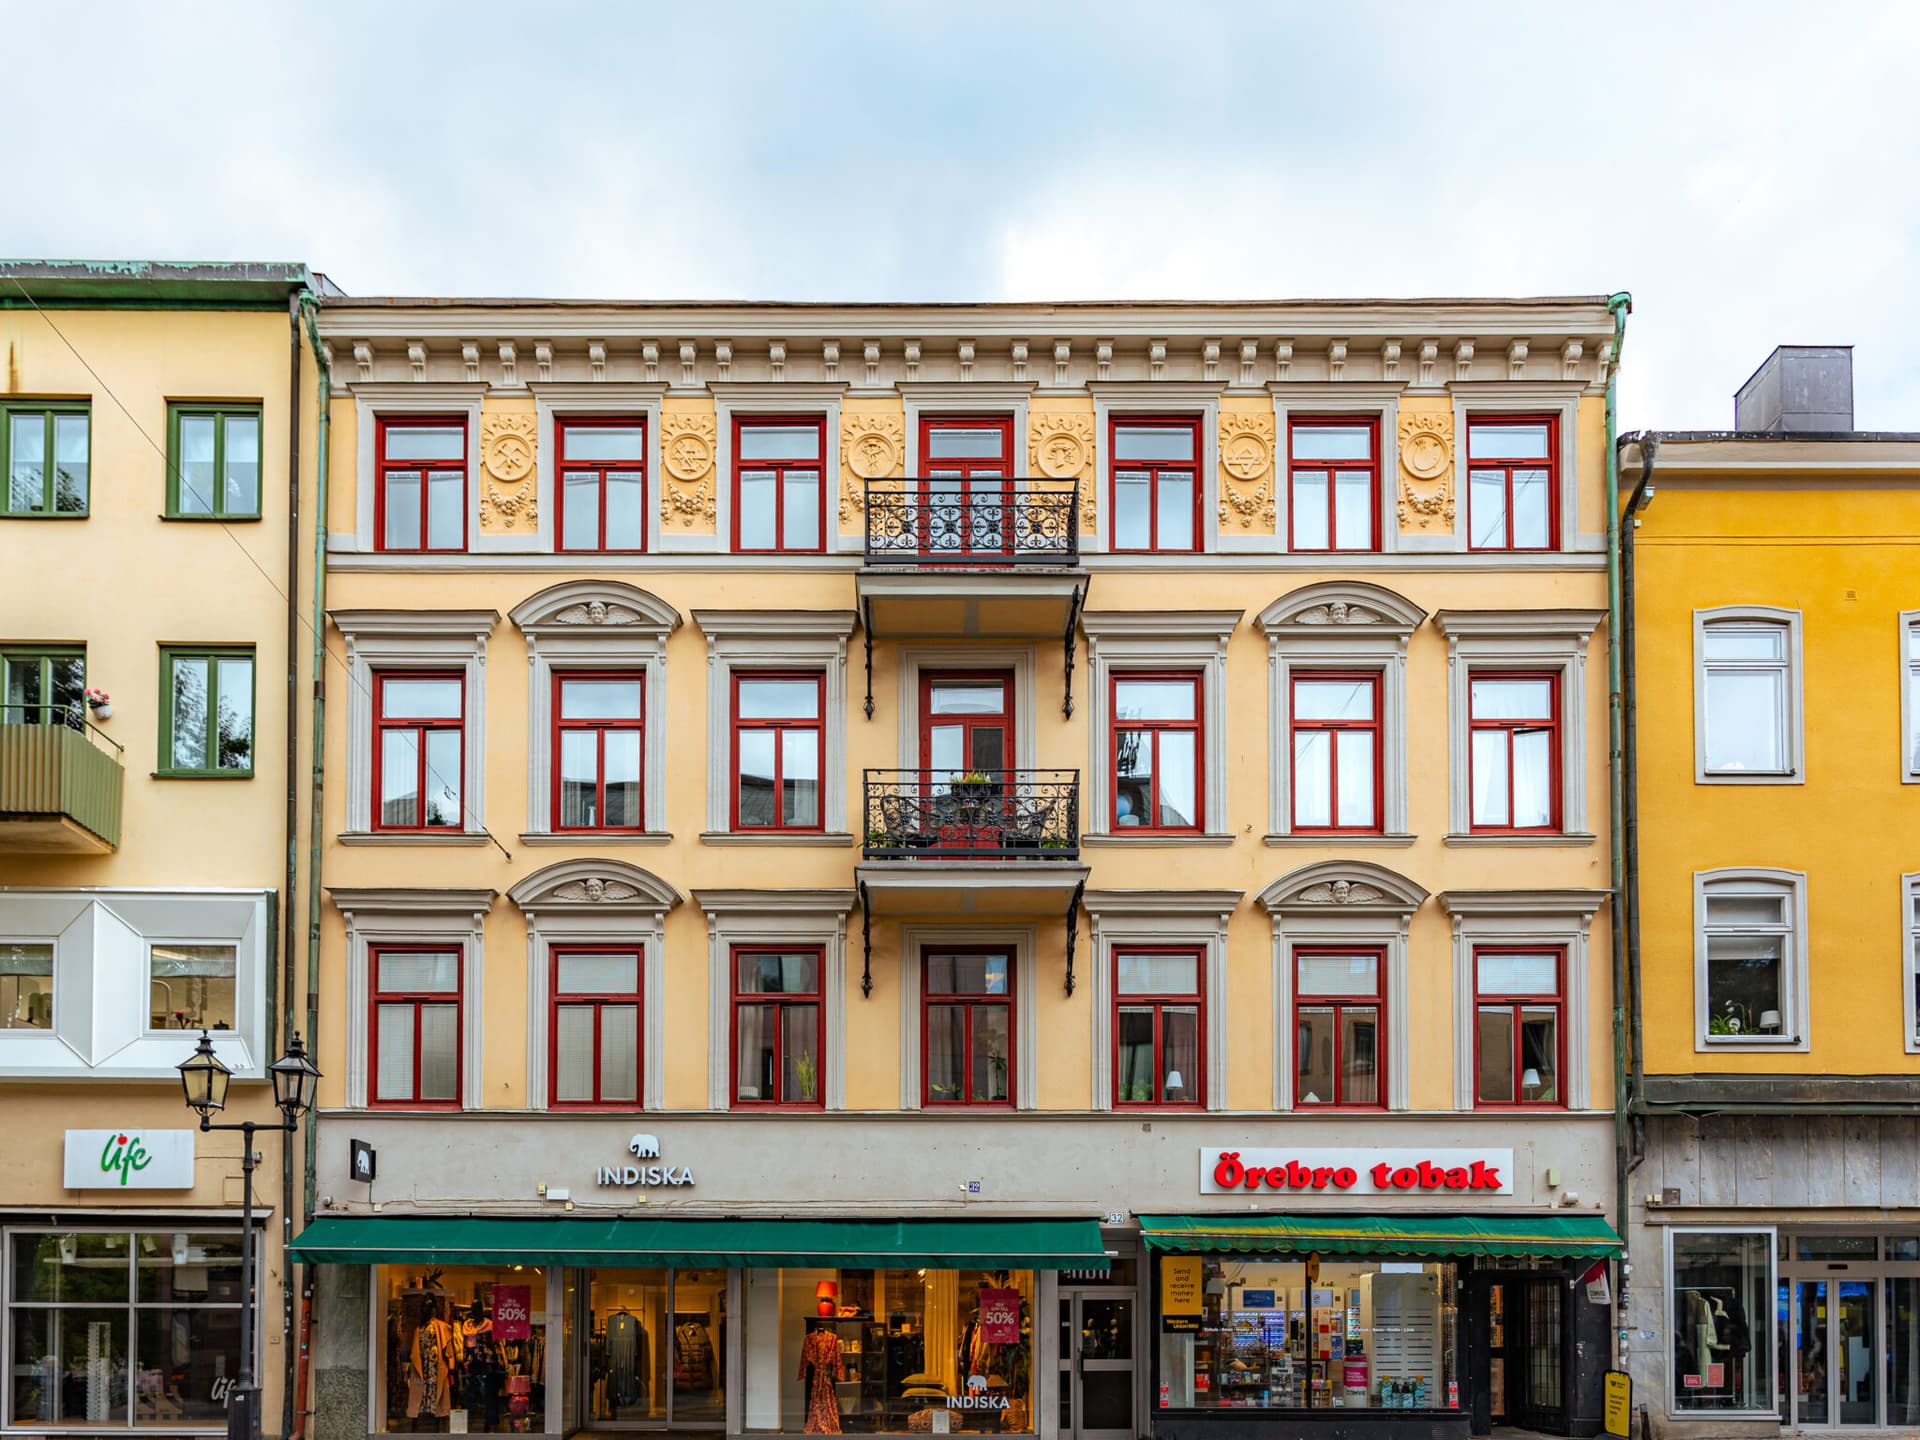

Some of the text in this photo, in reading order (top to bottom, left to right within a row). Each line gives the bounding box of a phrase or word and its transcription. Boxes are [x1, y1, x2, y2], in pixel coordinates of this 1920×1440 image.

[101, 1133, 152, 1185] life
[597, 1166, 696, 1185] INDISKA
[1214, 1152, 1502, 1188] Örebro tobak
[1111, 1213, 1123, 1223] 32
[498, 1308, 526, 1320] 50%
[986, 1312, 1014, 1324] 50%
[211, 1377, 240, 1408] lif
[946, 1396, 1010, 1408] INDISKA
